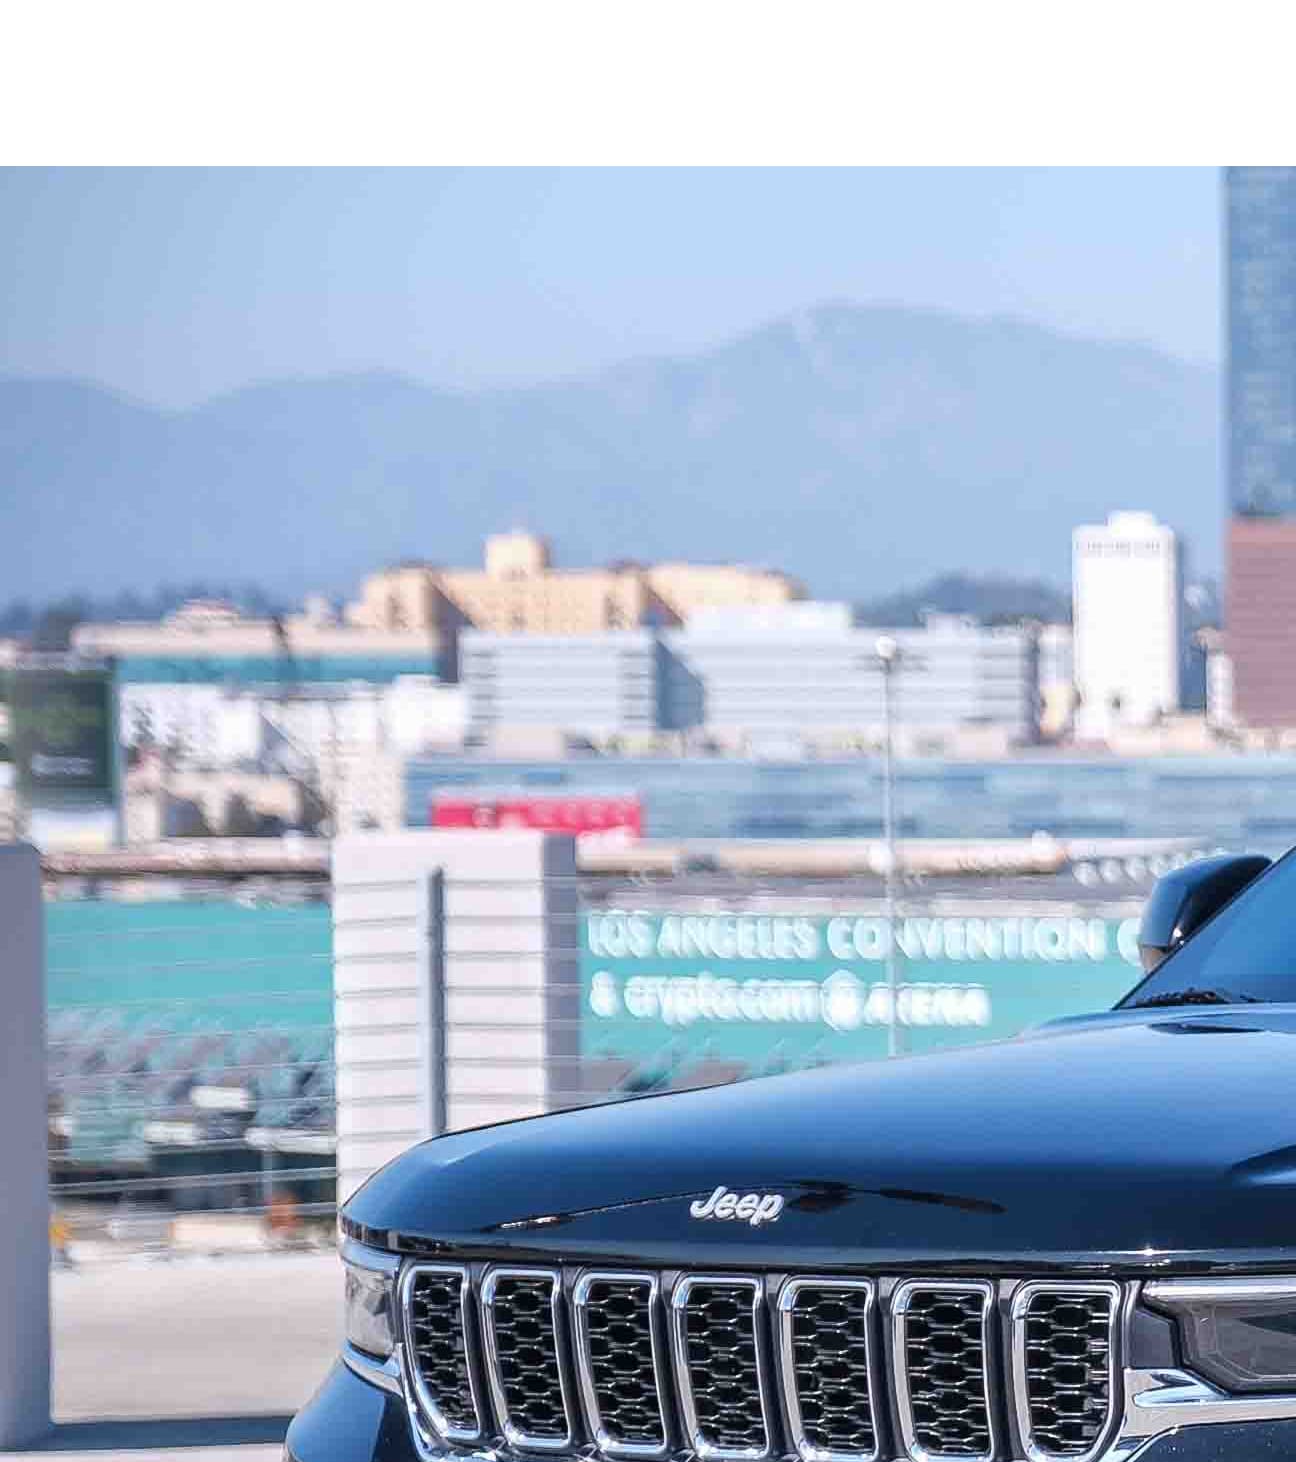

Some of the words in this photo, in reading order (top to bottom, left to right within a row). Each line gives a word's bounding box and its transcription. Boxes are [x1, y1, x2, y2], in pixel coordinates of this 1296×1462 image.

[587, 912, 655, 958] LOS
[657, 912, 820, 959] ANGELES
[689, 1185, 785, 1227] Jeep
